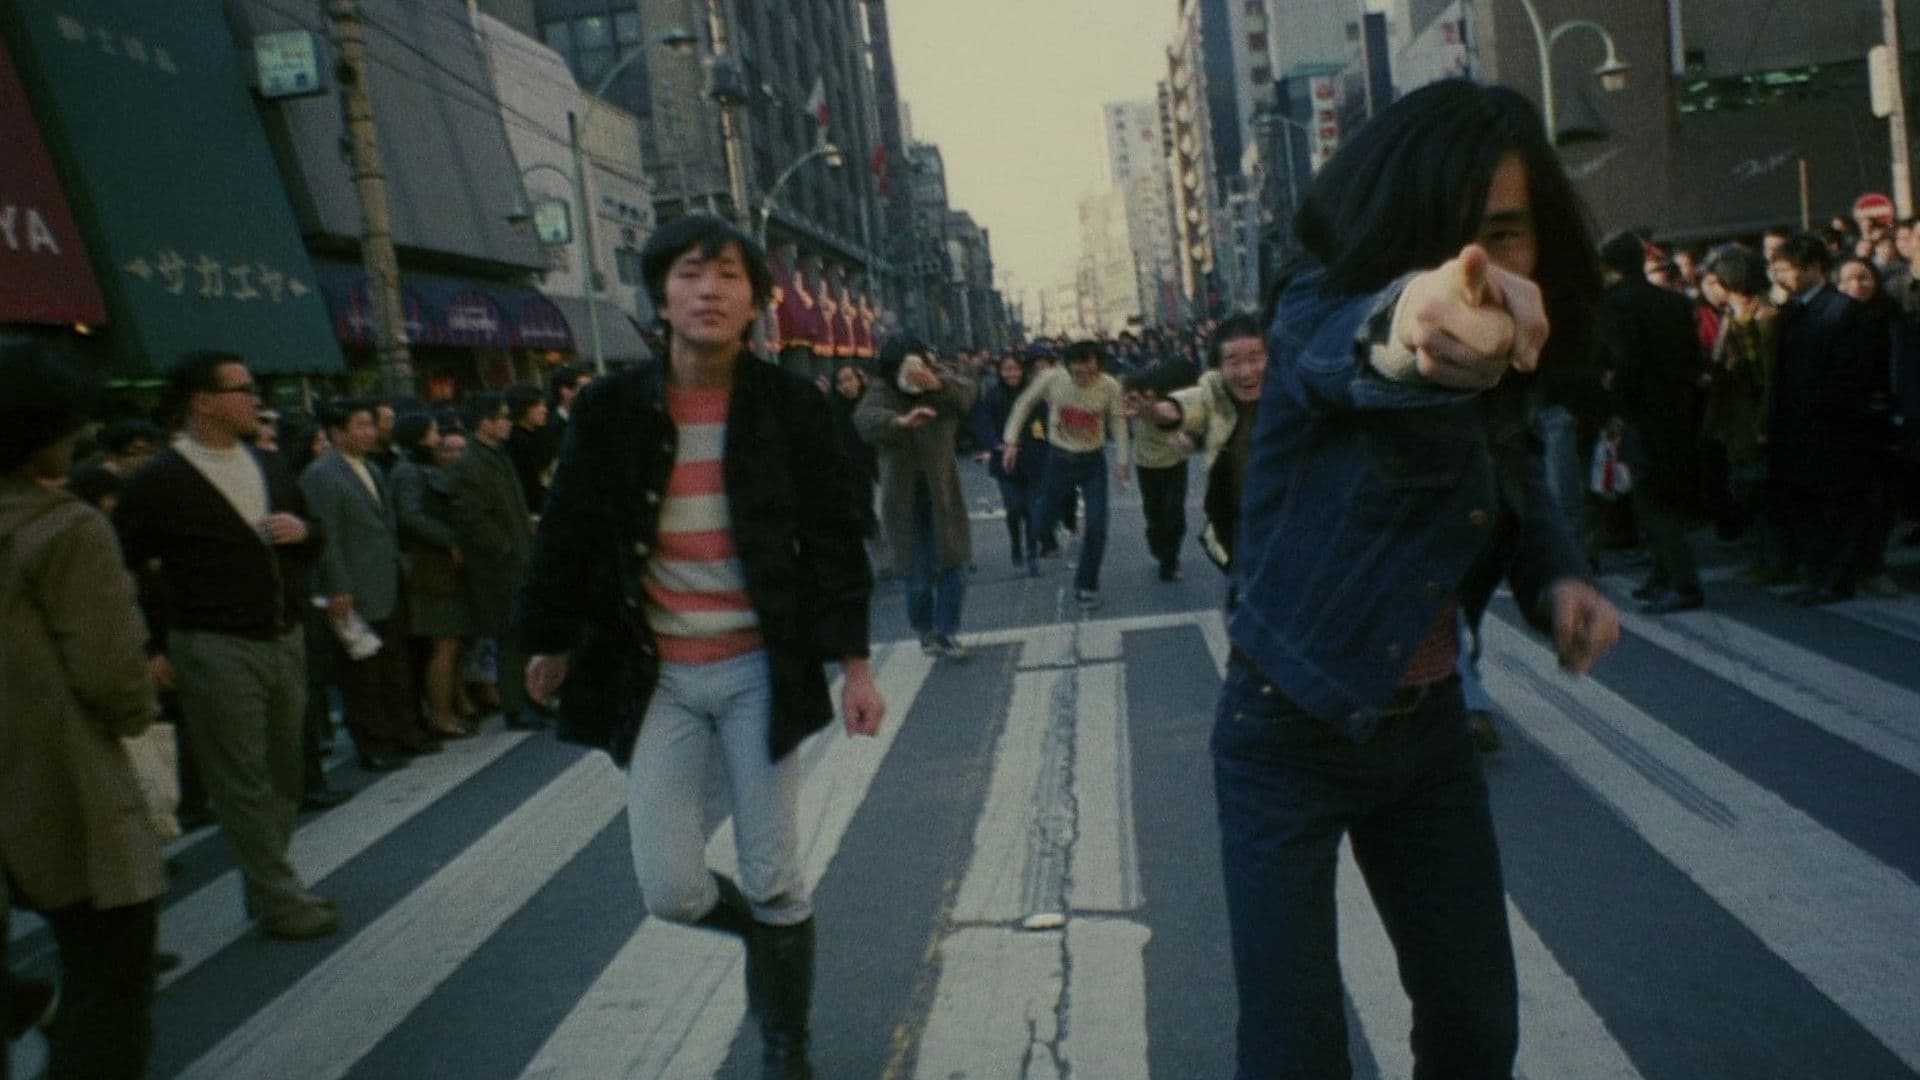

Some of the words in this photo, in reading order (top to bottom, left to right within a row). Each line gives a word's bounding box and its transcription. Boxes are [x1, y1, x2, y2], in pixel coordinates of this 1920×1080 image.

[0, 206, 61, 255] YA
[156, 250, 284, 303] サカエヤ
